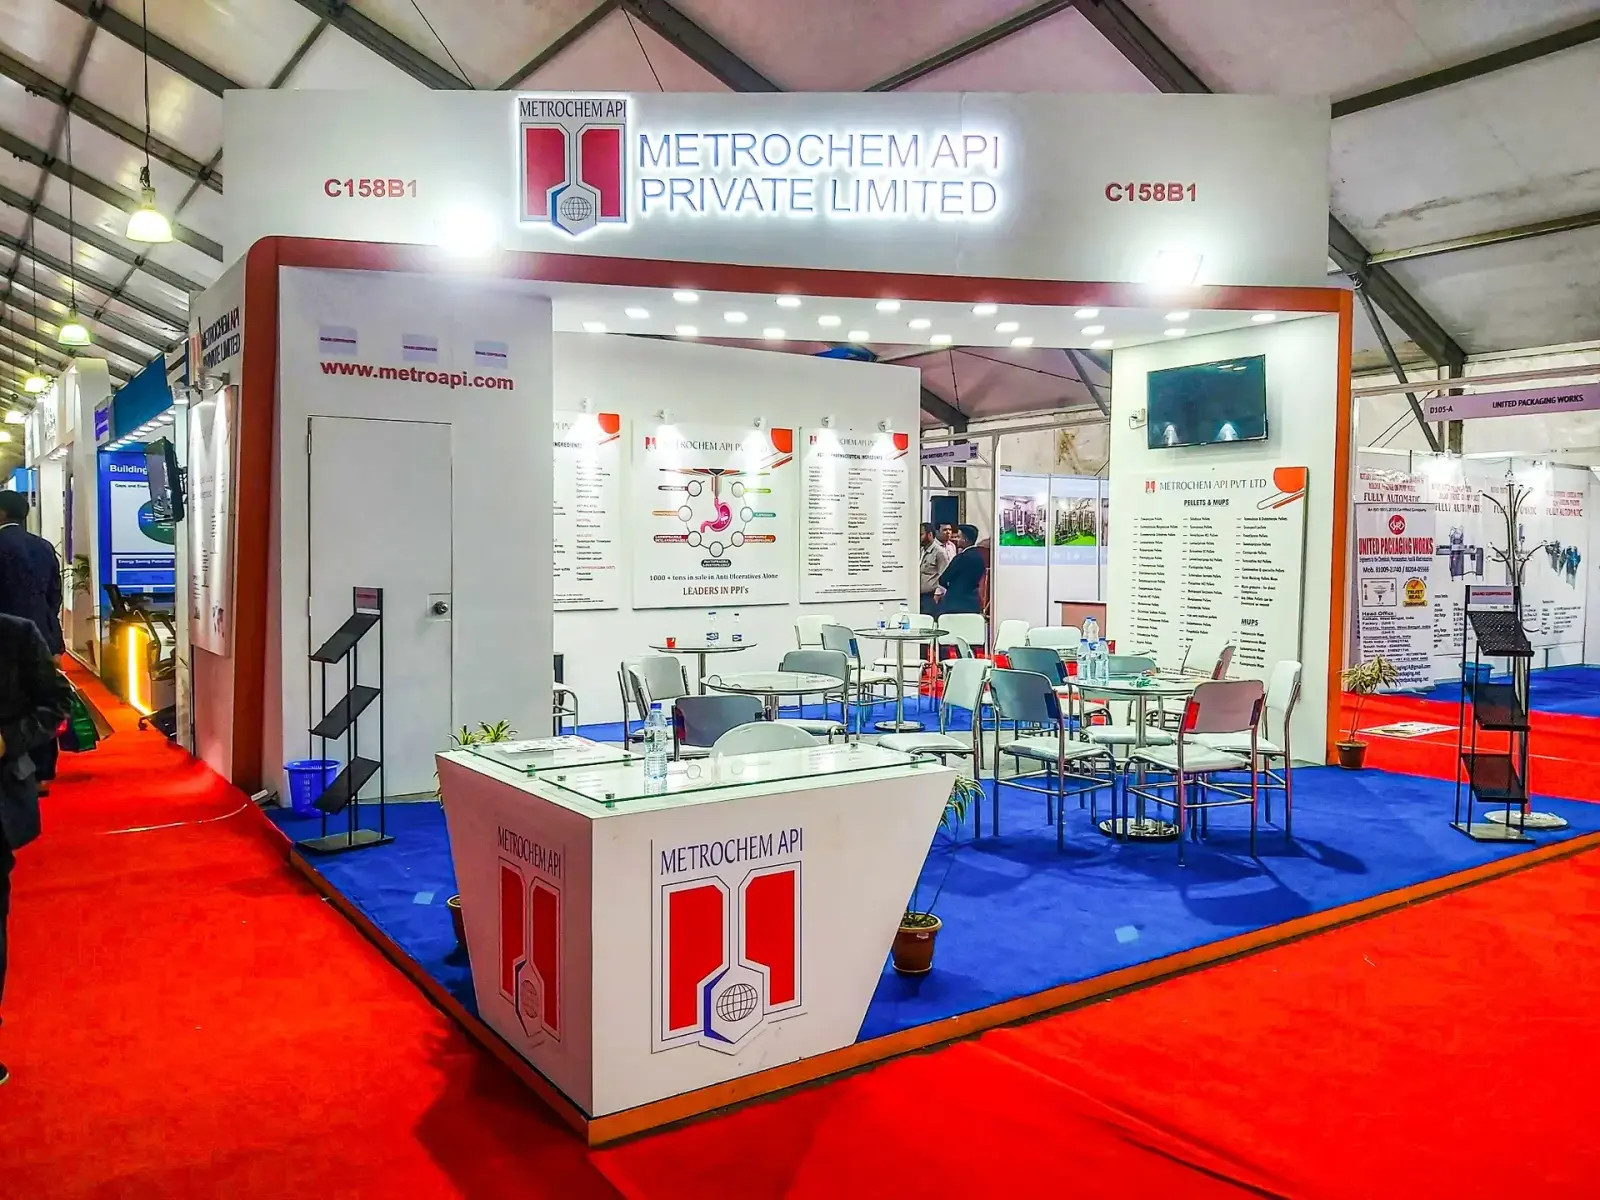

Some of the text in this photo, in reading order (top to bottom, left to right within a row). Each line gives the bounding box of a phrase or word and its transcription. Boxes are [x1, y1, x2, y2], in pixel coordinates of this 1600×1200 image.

[519, 100, 627, 118] METROCHEM API
[639, 133, 999, 169] METROCHEM API
[323, 178, 418, 198] C158B1
[640, 178, 997, 215] PRIVATE LIMITED
[1105, 182, 1196, 201] C158B1
[320, 361, 514, 390] www.metroapi.com
[1429, 394, 1584, 414] D105-A UNITED PACKAGING WORKS
[719, 442, 733, 451] API
[110, 464, 148, 476] Building
[1159, 478, 1267, 492] METROCHEM API PVT LTD
[1183, 499, 1207, 507] PELLETS
[1363, 492, 1420, 503] FULLY AUTOMATIC
[1358, 537, 1434, 555] UNITED PACKAGING WORKS
[683, 586, 749, 596] LEADERS IN PPI's
[1240, 618, 1259, 626] MUPS
[498, 825, 561, 880] METROCHEM API
[660, 827, 803, 876] METROCHEM API
